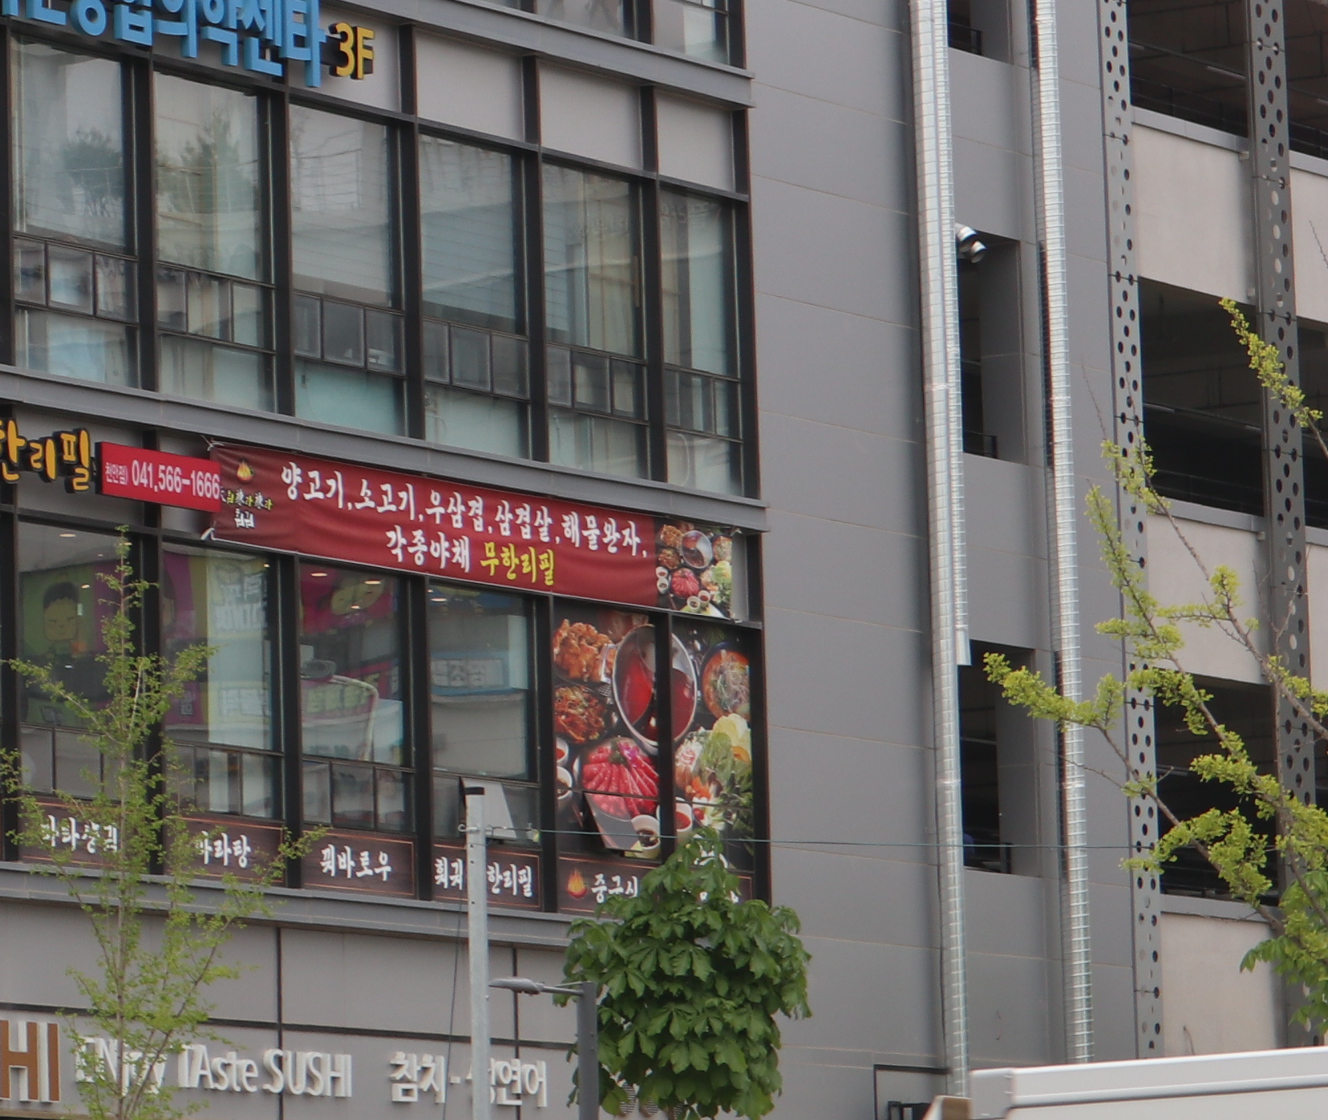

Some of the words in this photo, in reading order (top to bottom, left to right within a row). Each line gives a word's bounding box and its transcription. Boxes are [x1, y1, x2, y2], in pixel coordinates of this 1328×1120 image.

[334, 22, 375, 80] 3F
[386, 525, 471, 574] 각종야채
[480, 541, 555, 586] 무한리필
[263, 1048, 352, 1098] SUSHI
